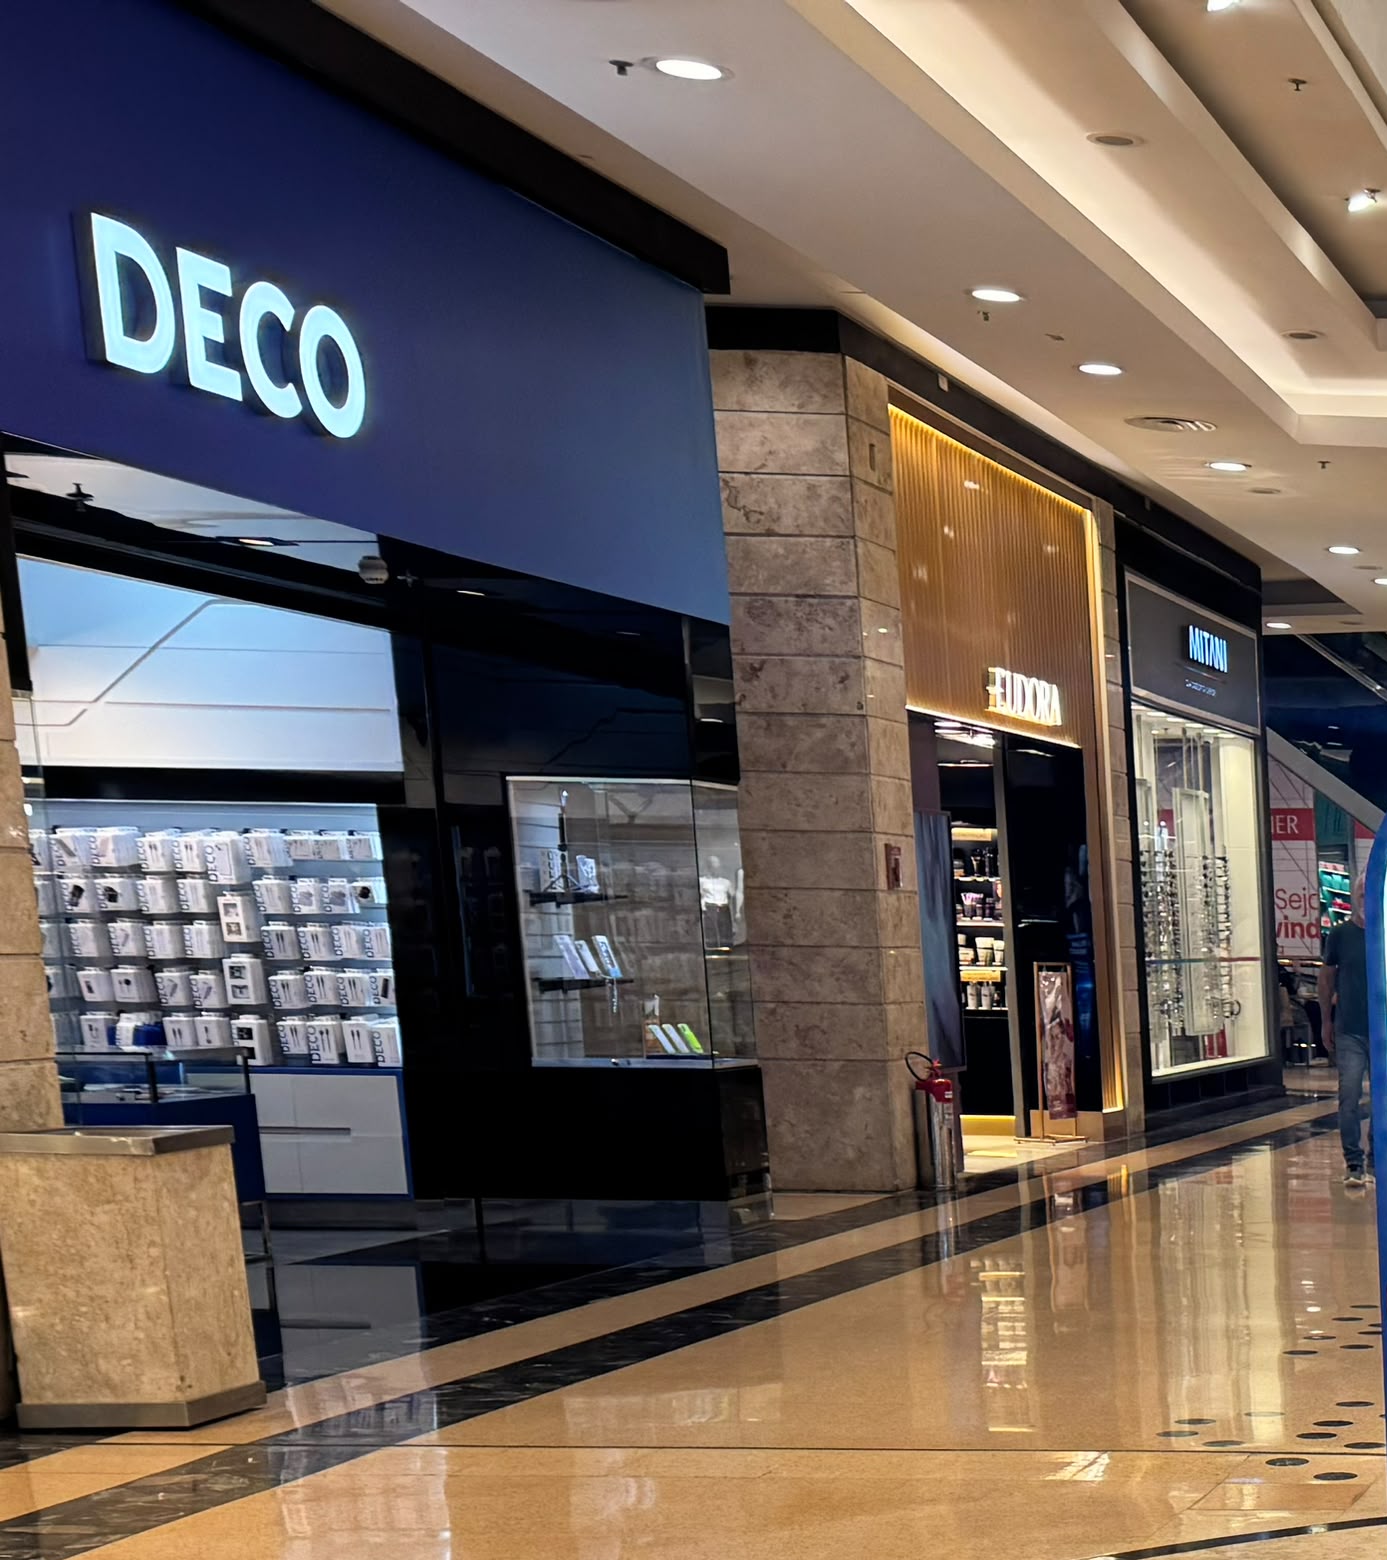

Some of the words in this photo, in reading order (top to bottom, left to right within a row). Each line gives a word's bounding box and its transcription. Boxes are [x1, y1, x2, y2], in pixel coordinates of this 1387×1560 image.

[92, 212, 366, 438] DECO
[986, 667, 1063, 727] EUDORA
[206, 844, 218, 882] DECO
[305, 975, 317, 1003] DECO
[370, 975, 381, 1004] DECO
[307, 1025, 321, 1062] DECO
[373, 1031, 385, 1063] DECO
